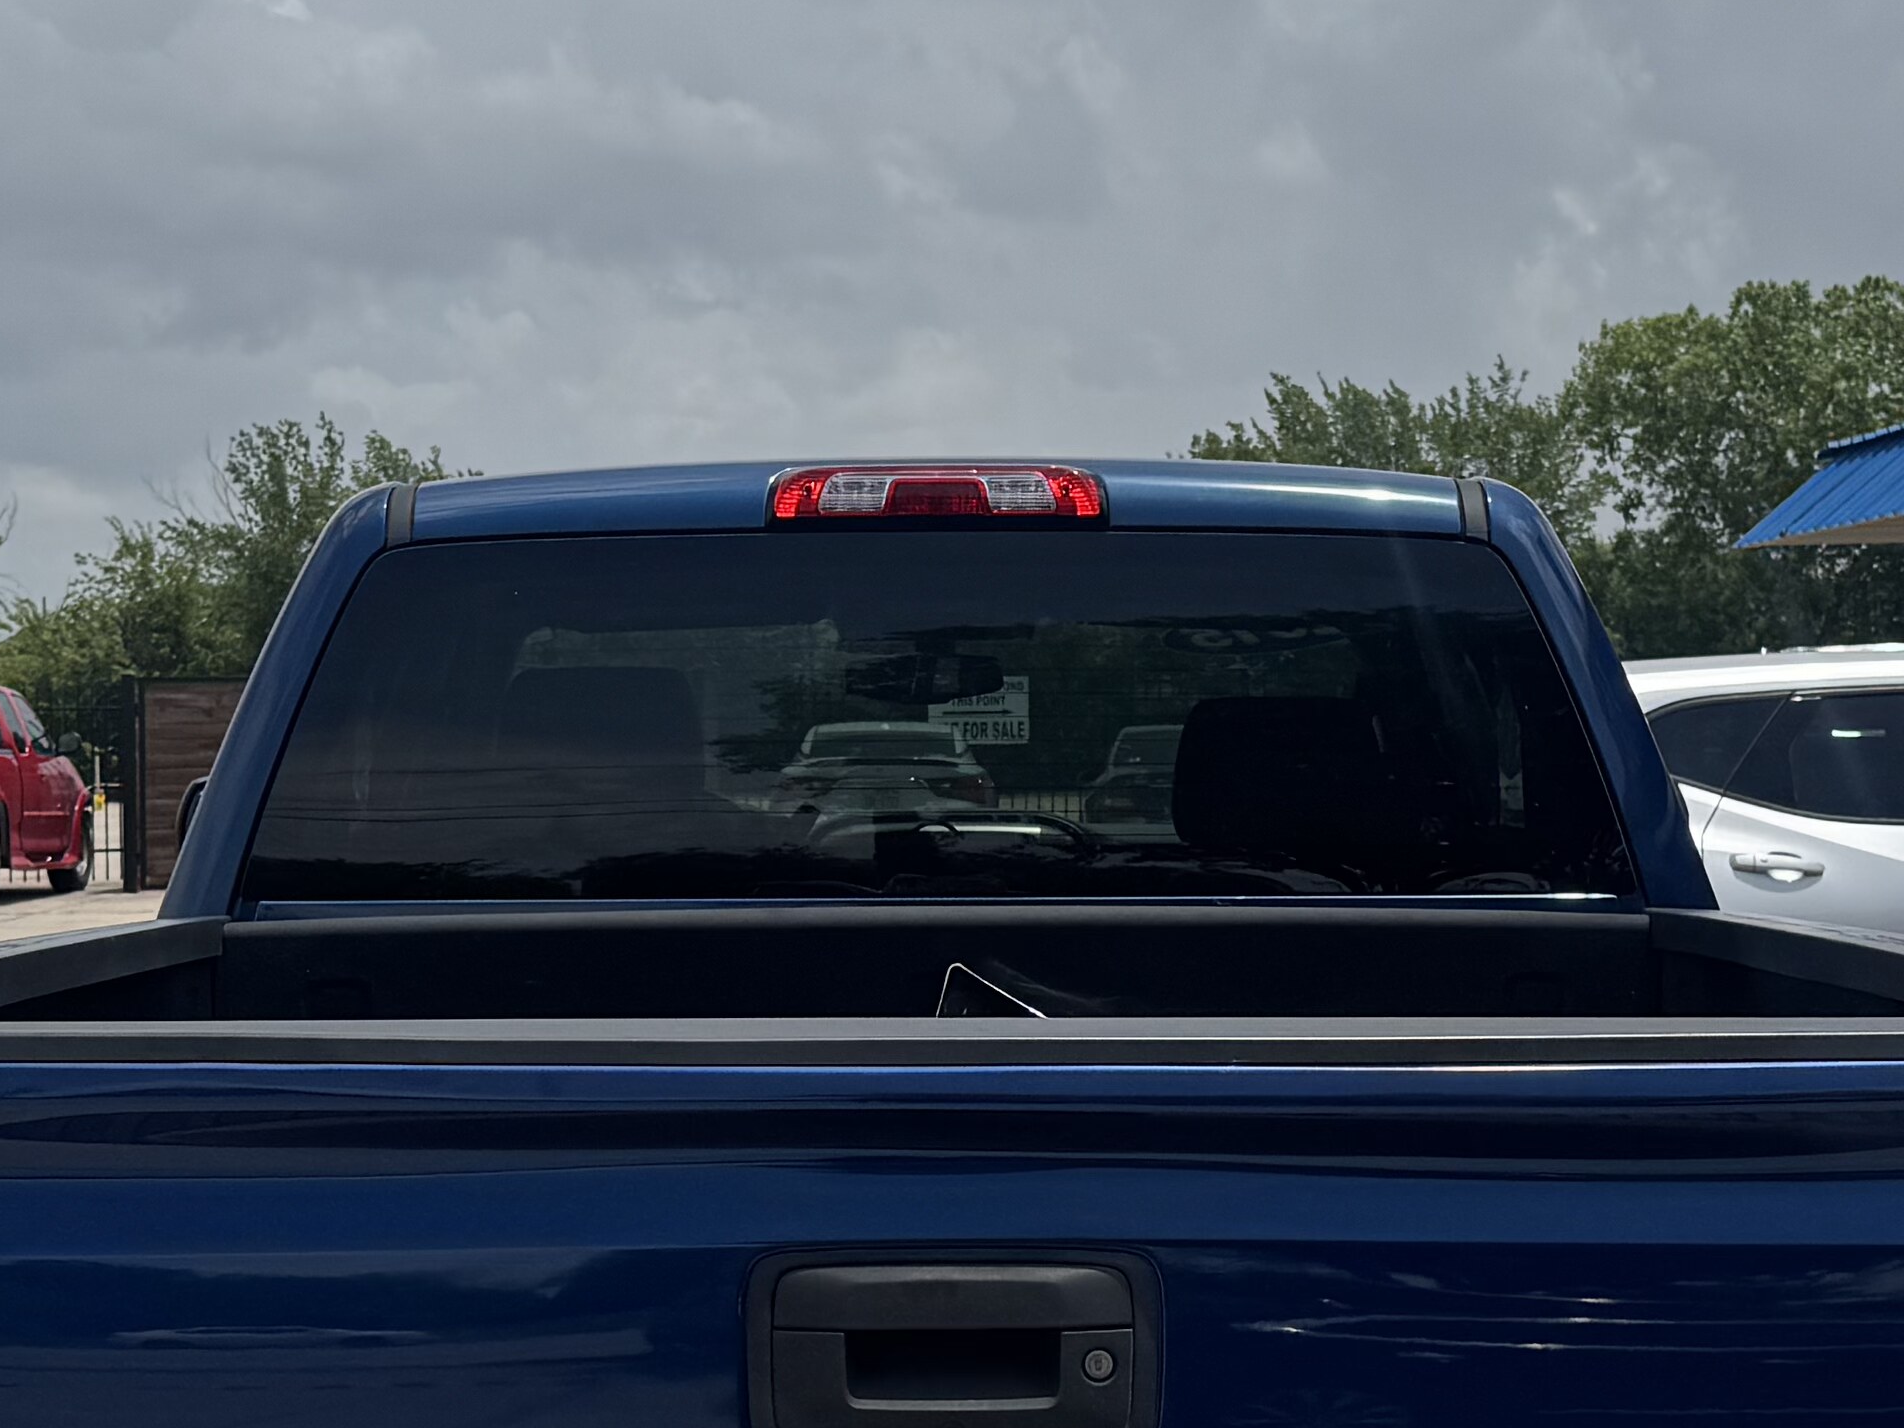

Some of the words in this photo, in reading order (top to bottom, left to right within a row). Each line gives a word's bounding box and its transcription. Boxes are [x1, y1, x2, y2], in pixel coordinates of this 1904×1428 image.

[976, 695, 1006, 707] POINT
[963, 721, 989, 740] FOR
[992, 721, 1025, 740] SALE
